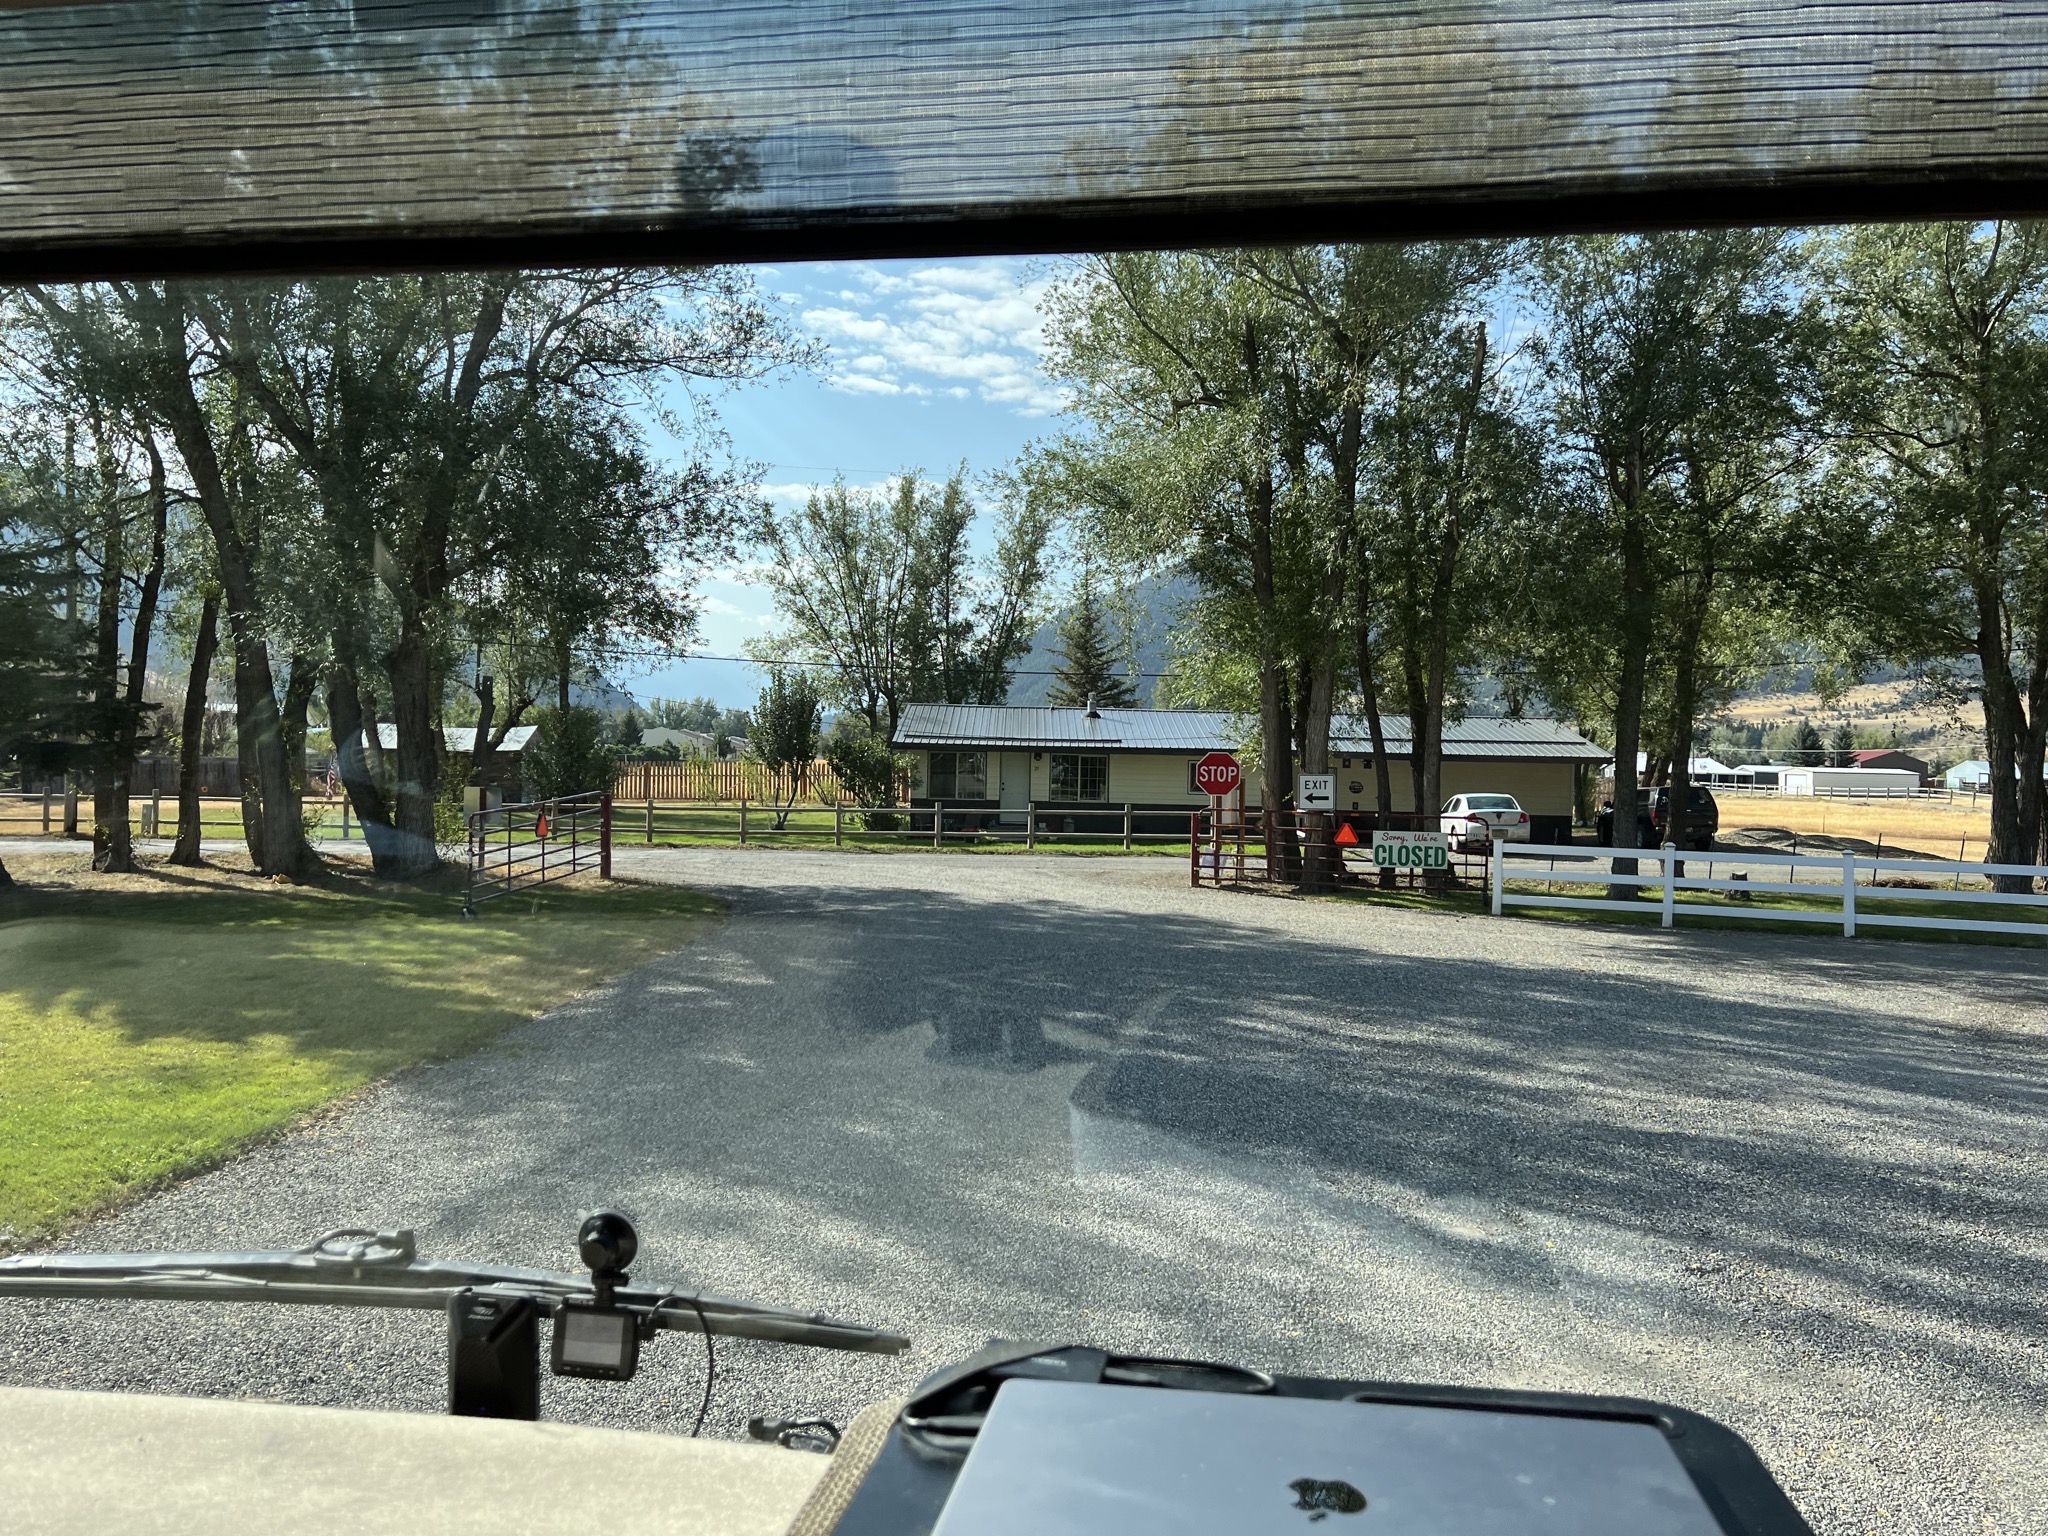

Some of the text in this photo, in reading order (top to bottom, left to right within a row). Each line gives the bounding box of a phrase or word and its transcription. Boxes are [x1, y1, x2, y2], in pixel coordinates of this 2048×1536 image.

[1199, 765, 1238, 783] STOP
[1304, 780, 1329, 790] EXIT
[1413, 833, 1439, 843] We're
[1374, 844, 1447, 868] CLOSED
